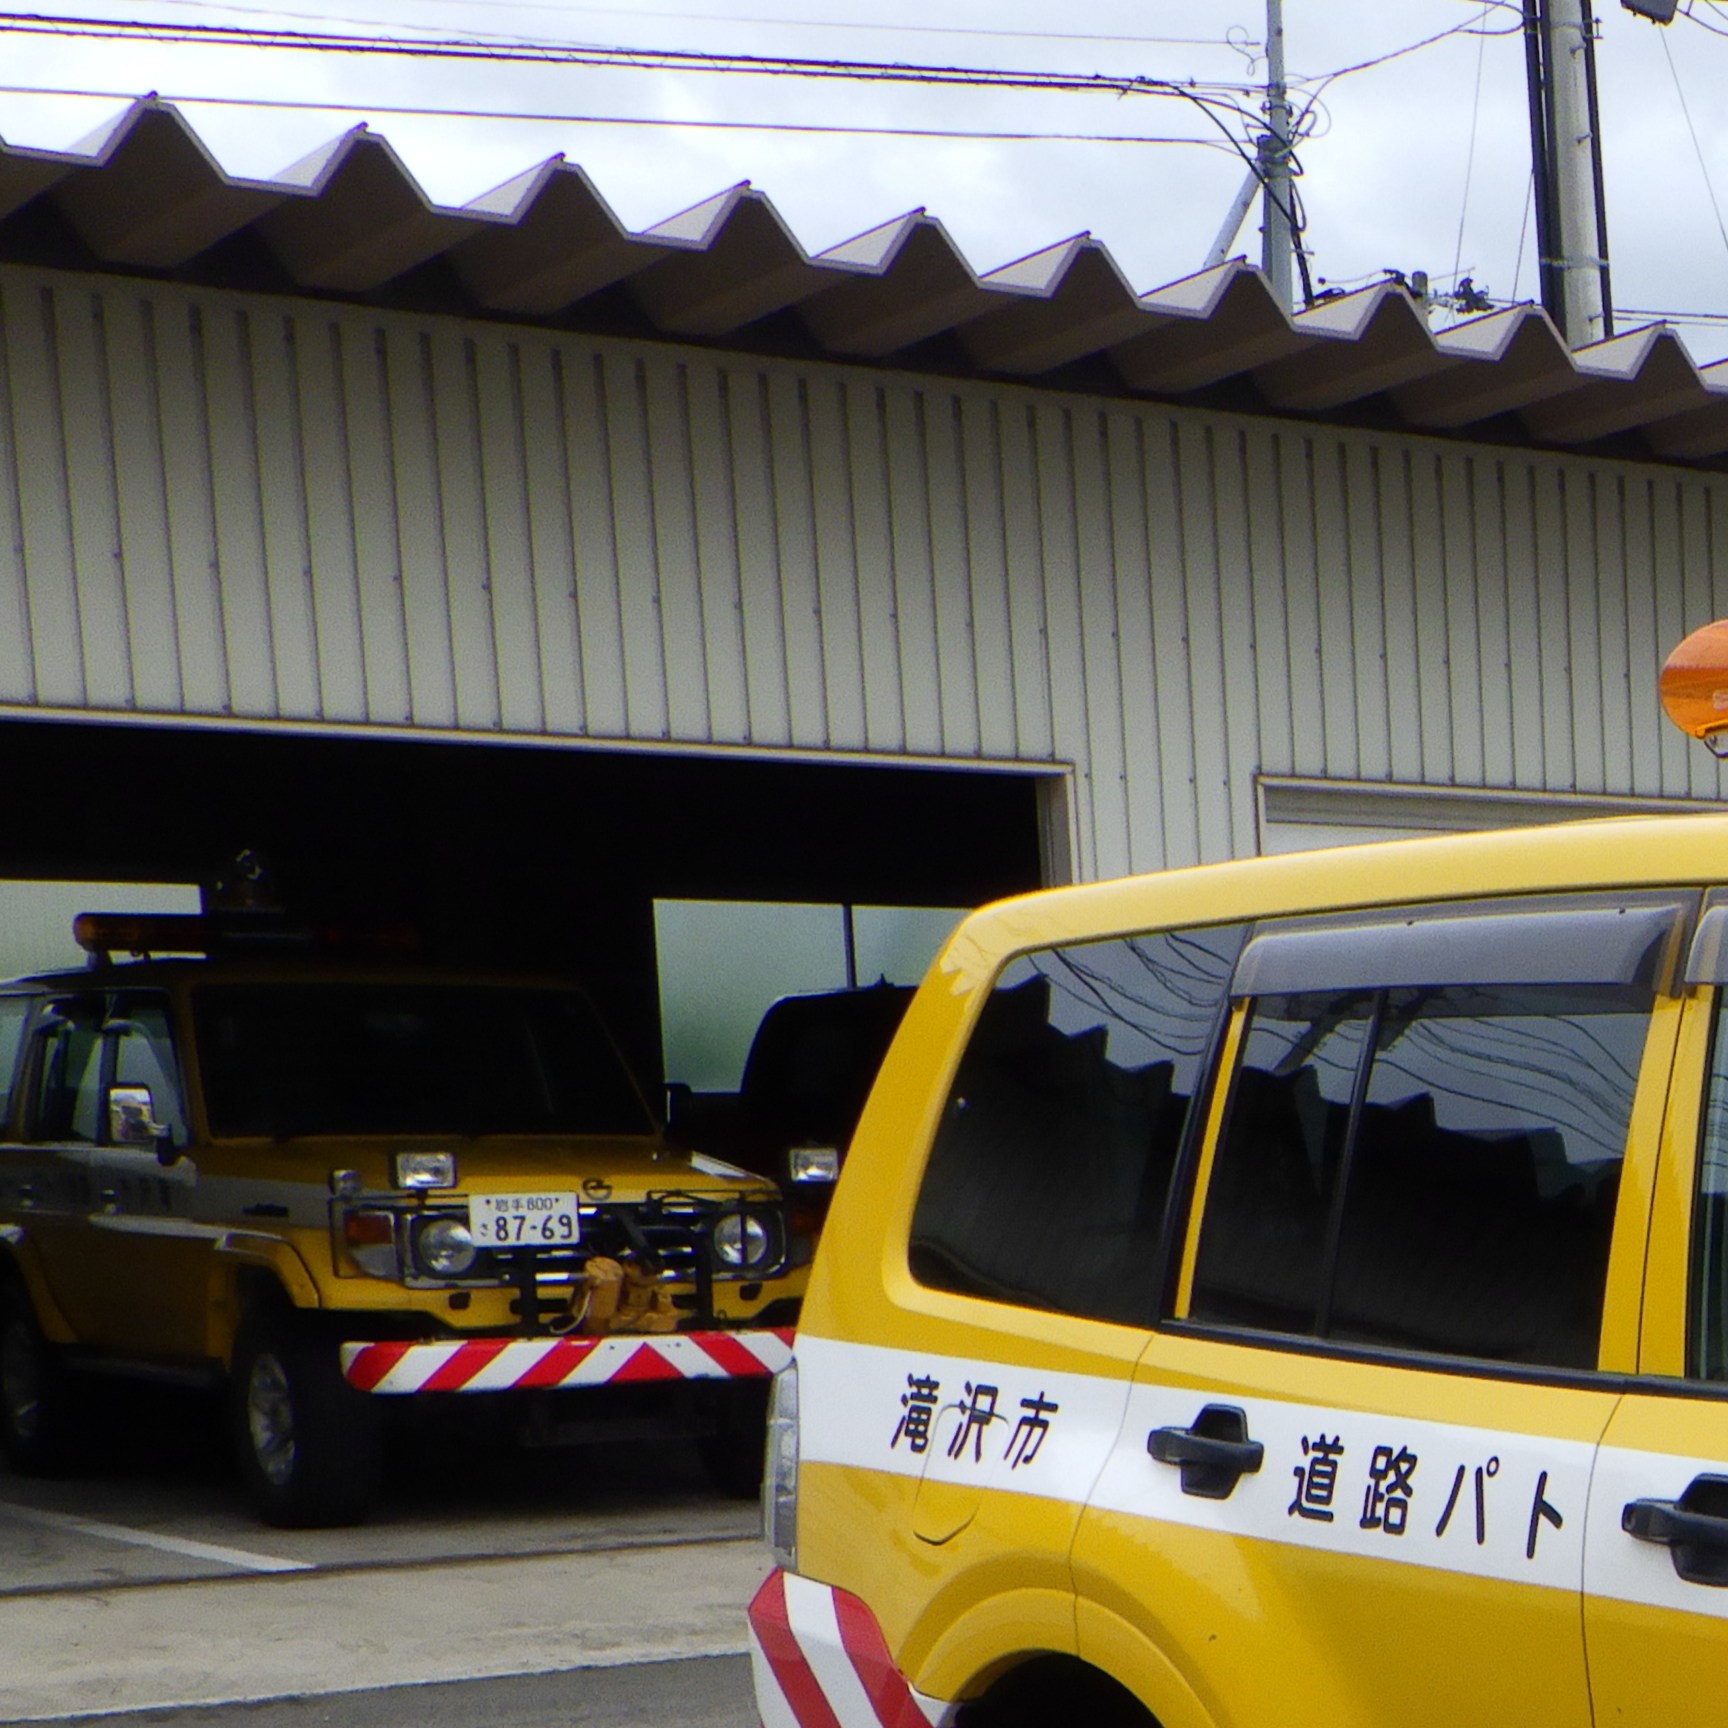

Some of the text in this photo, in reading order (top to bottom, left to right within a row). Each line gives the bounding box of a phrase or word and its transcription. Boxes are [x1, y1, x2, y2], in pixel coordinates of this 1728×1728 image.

[495, 1213, 573, 1242] 87-69
[890, 1372, 1060, 1471] 滝沢市
